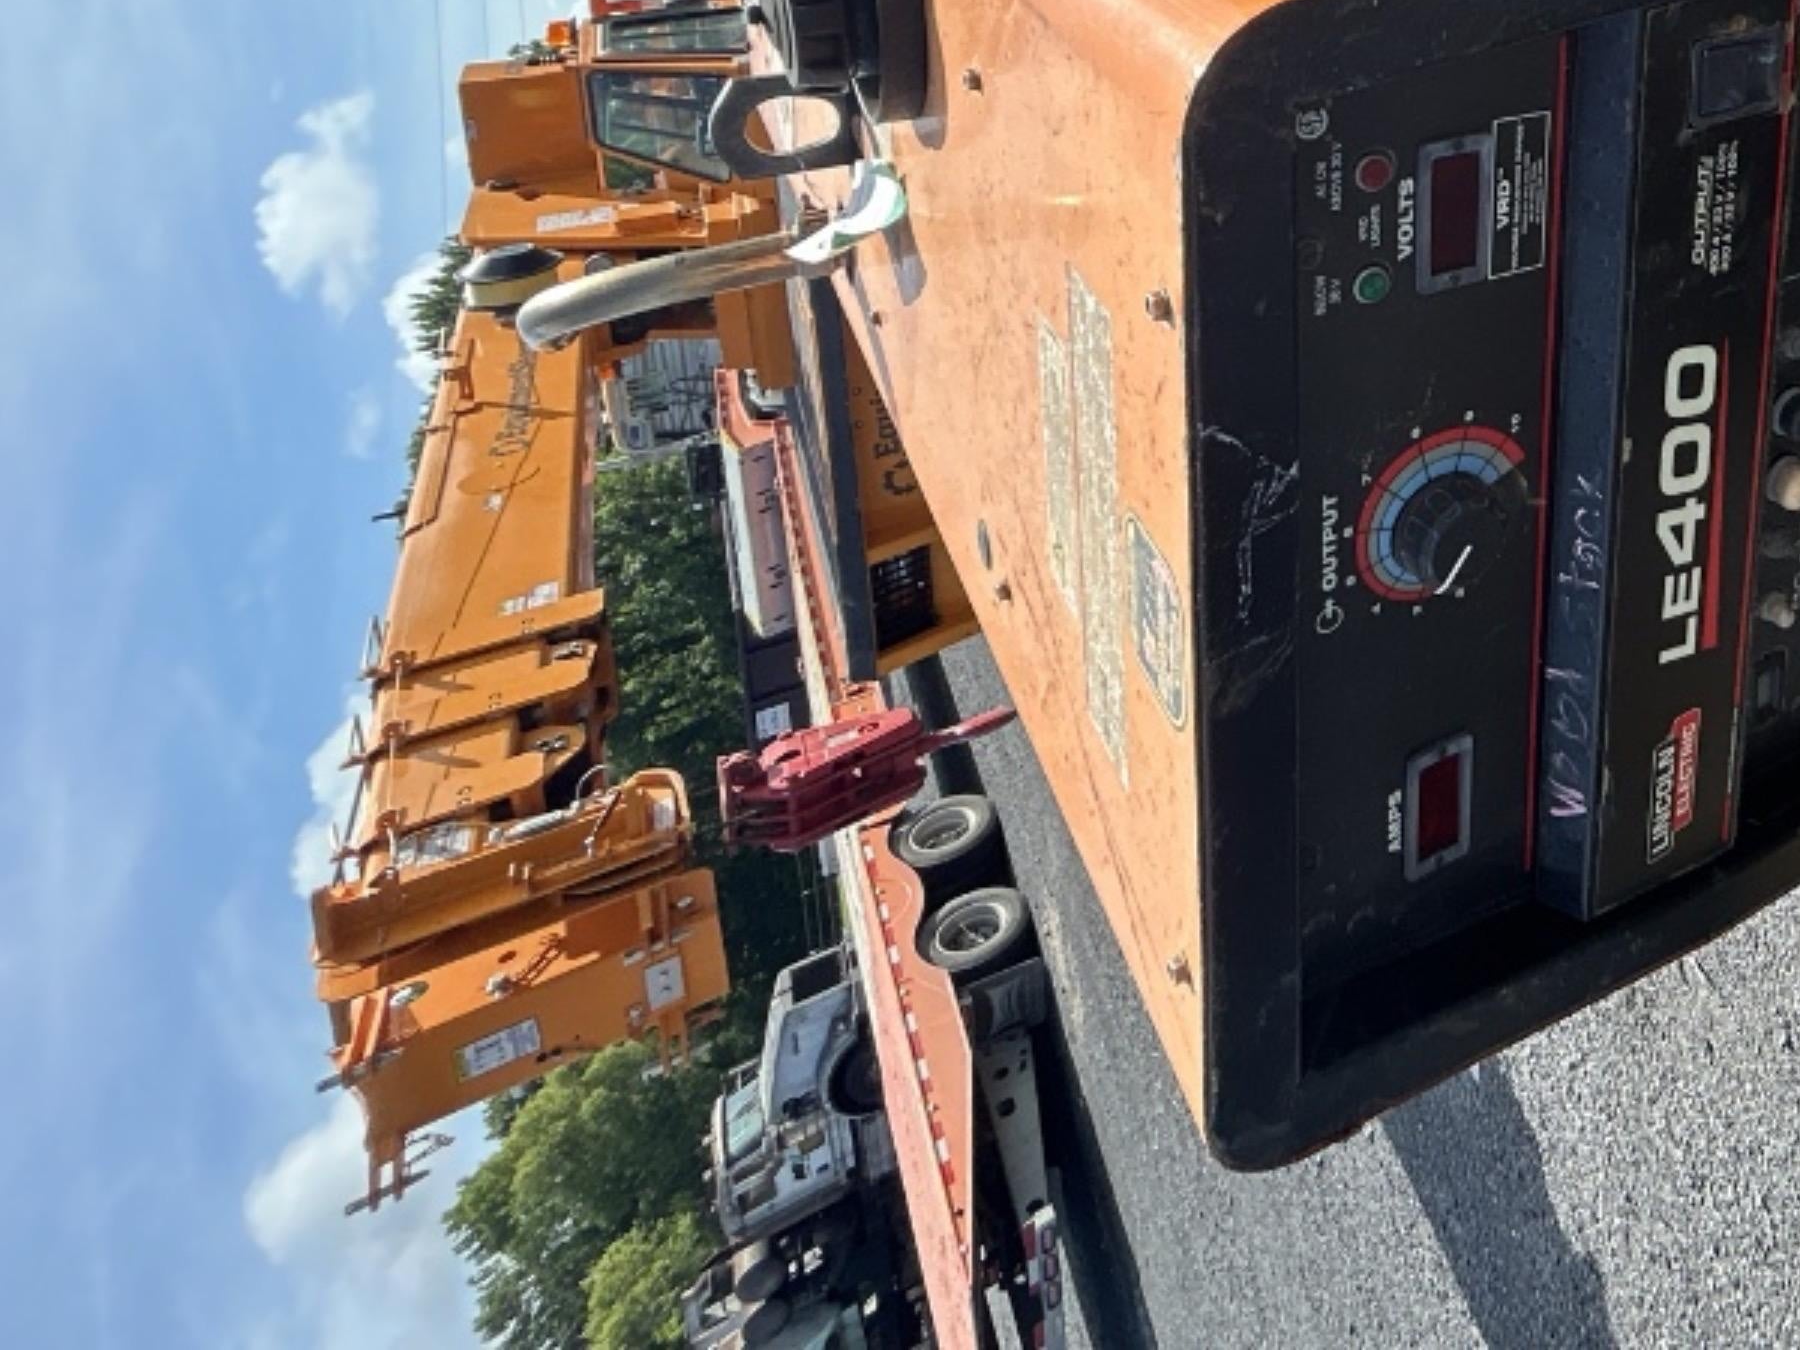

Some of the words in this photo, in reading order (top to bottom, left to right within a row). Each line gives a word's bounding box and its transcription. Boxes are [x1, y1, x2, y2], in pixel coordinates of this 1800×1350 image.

[1397, 175, 1414, 261] VOLTS
[1321, 493, 1339, 591] OUTPUT
[1655, 342, 1718, 663] LE400
[1652, 744, 1675, 853] LINCOLN
[1676, 721, 1696, 816] ELECTRIC
[1387, 788, 1402, 851] AMPS
